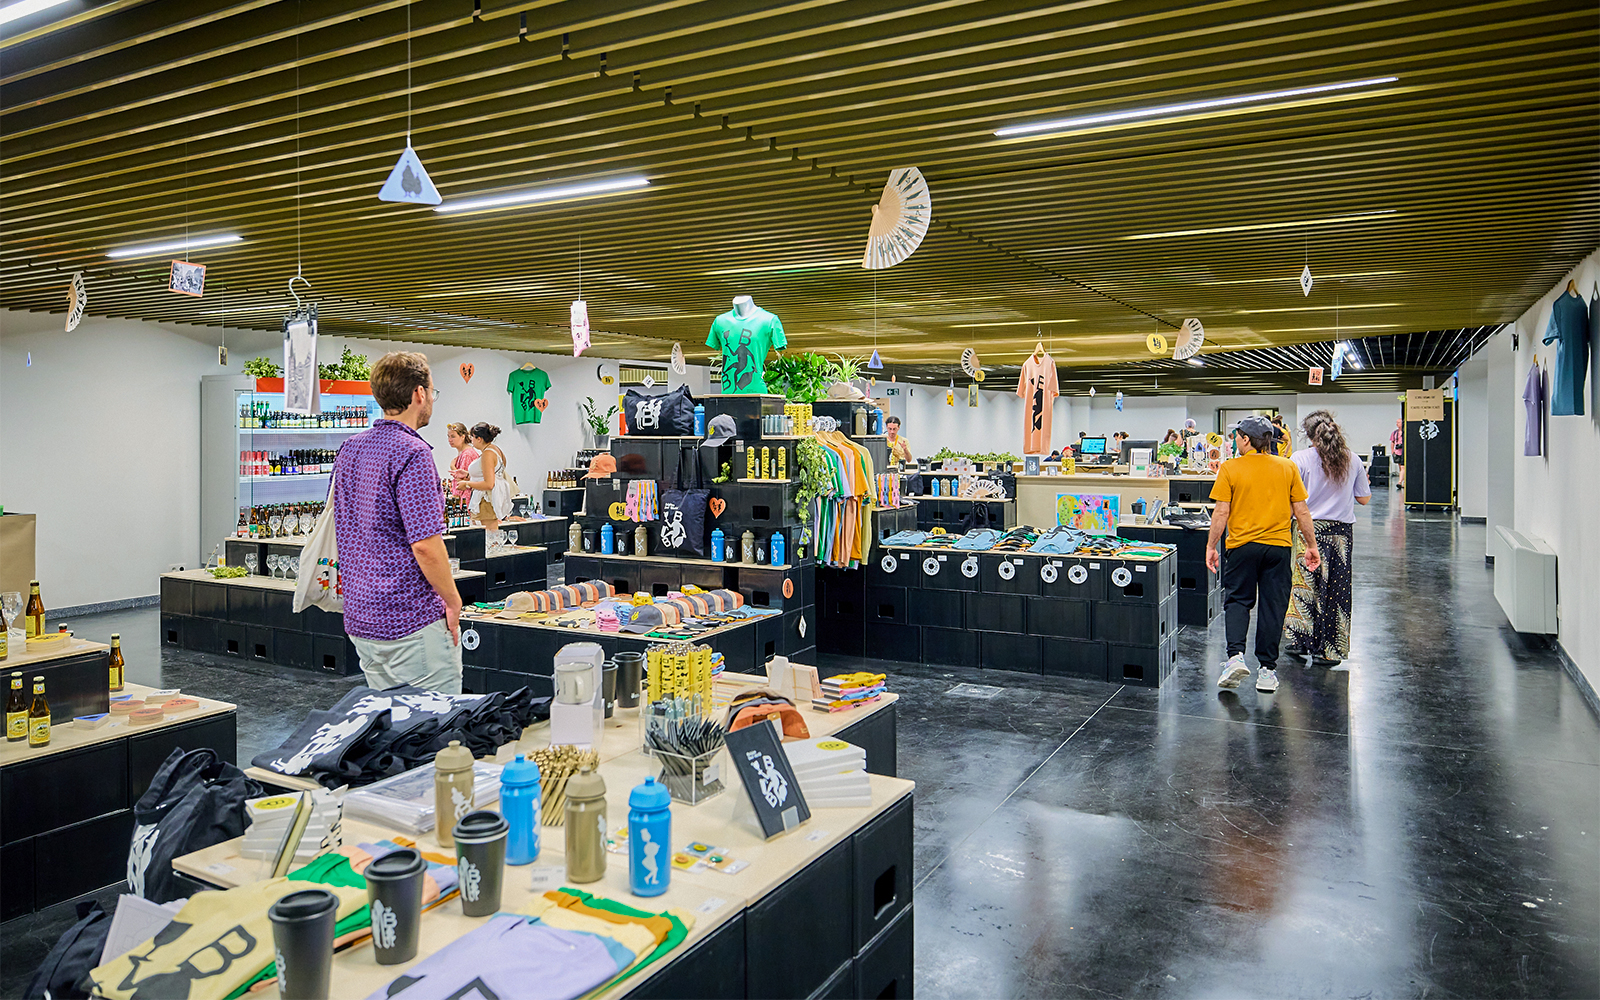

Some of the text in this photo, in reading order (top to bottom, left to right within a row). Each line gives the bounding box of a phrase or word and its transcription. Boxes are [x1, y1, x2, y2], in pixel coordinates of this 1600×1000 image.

[738, 328, 752, 346] B
[642, 408, 654, 426] B
[673, 511, 683, 522] B
[661, 537, 671, 548] B
[762, 754, 775, 770] B
[765, 792, 778, 808] B
[468, 868, 481, 883] B
[383, 911, 398, 928] B
[178, 924, 257, 980] B
